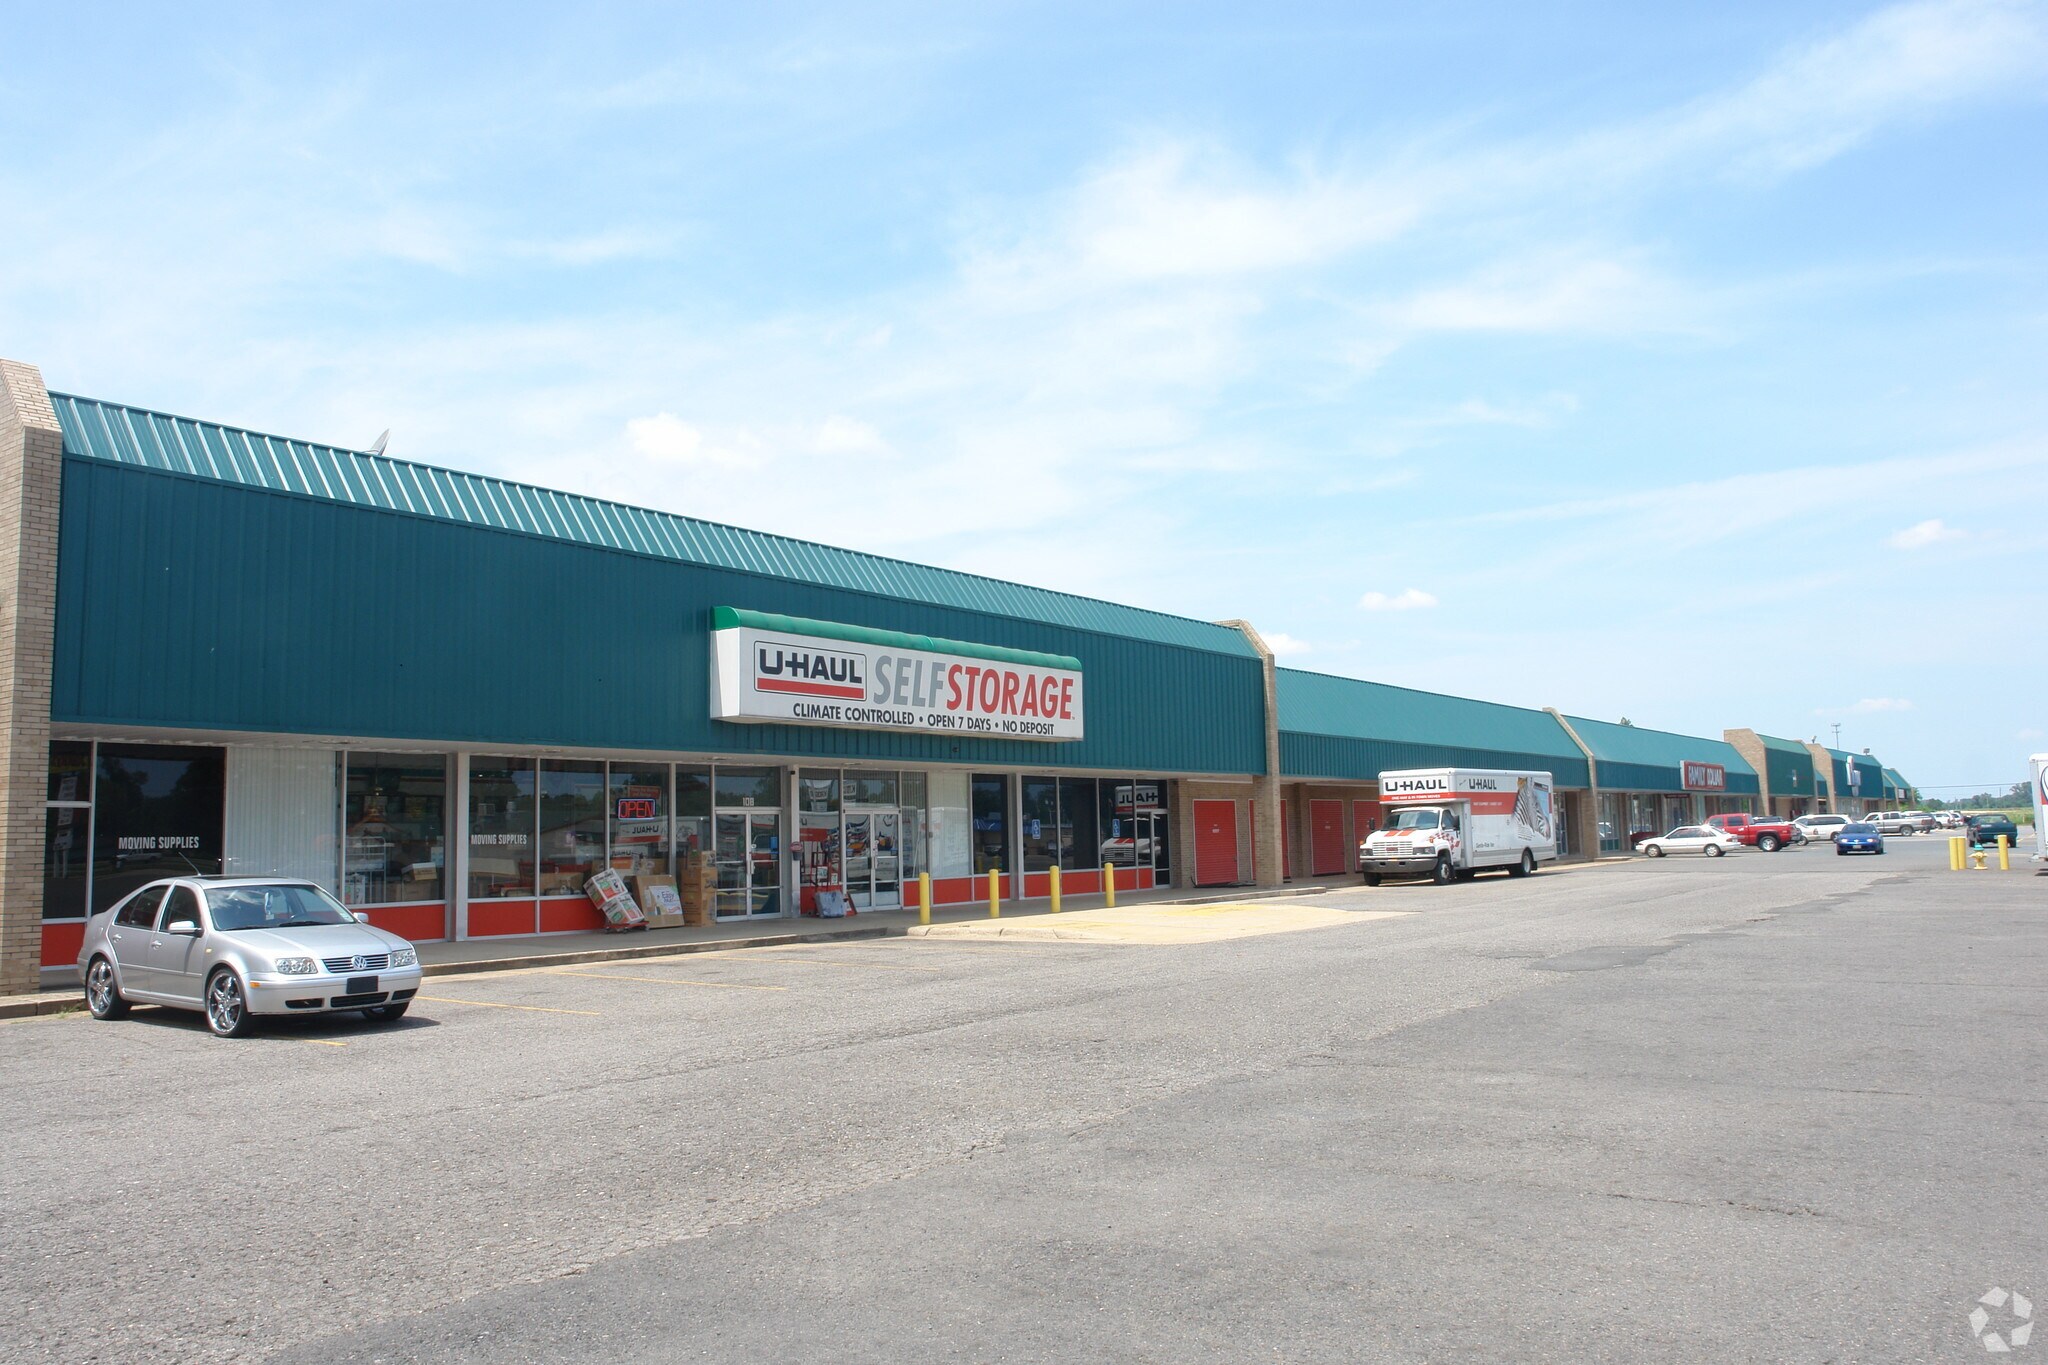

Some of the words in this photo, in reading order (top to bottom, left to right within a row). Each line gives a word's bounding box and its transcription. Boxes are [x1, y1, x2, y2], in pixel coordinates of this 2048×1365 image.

[759, 648, 863, 684] U-HAUL
[873, 655, 946, 708] SELF
[946, 663, 1074, 720] STORAGE
[793, 703, 842, 720] CLIMATE
[845, 707, 915, 725] CONTROLLED
[927, 714, 955, 728] OPEN
[958, 717, 965, 729] 7
[967, 717, 992, 731] DAYS
[1002, 720, 1018, 733] NO
[1020, 721, 1055, 735] DEPOSIT
[1385, 779, 1447, 792] U-HAUL
[1469, 778, 1497, 790] U-HAUL
[619, 801, 653, 818] OPEN
[118, 837, 156, 850] MOVING
[158, 836, 200, 849] SUPPLIES
[471, 834, 497, 845] MOVING
[498, 834, 527, 845] SUPPLIES
